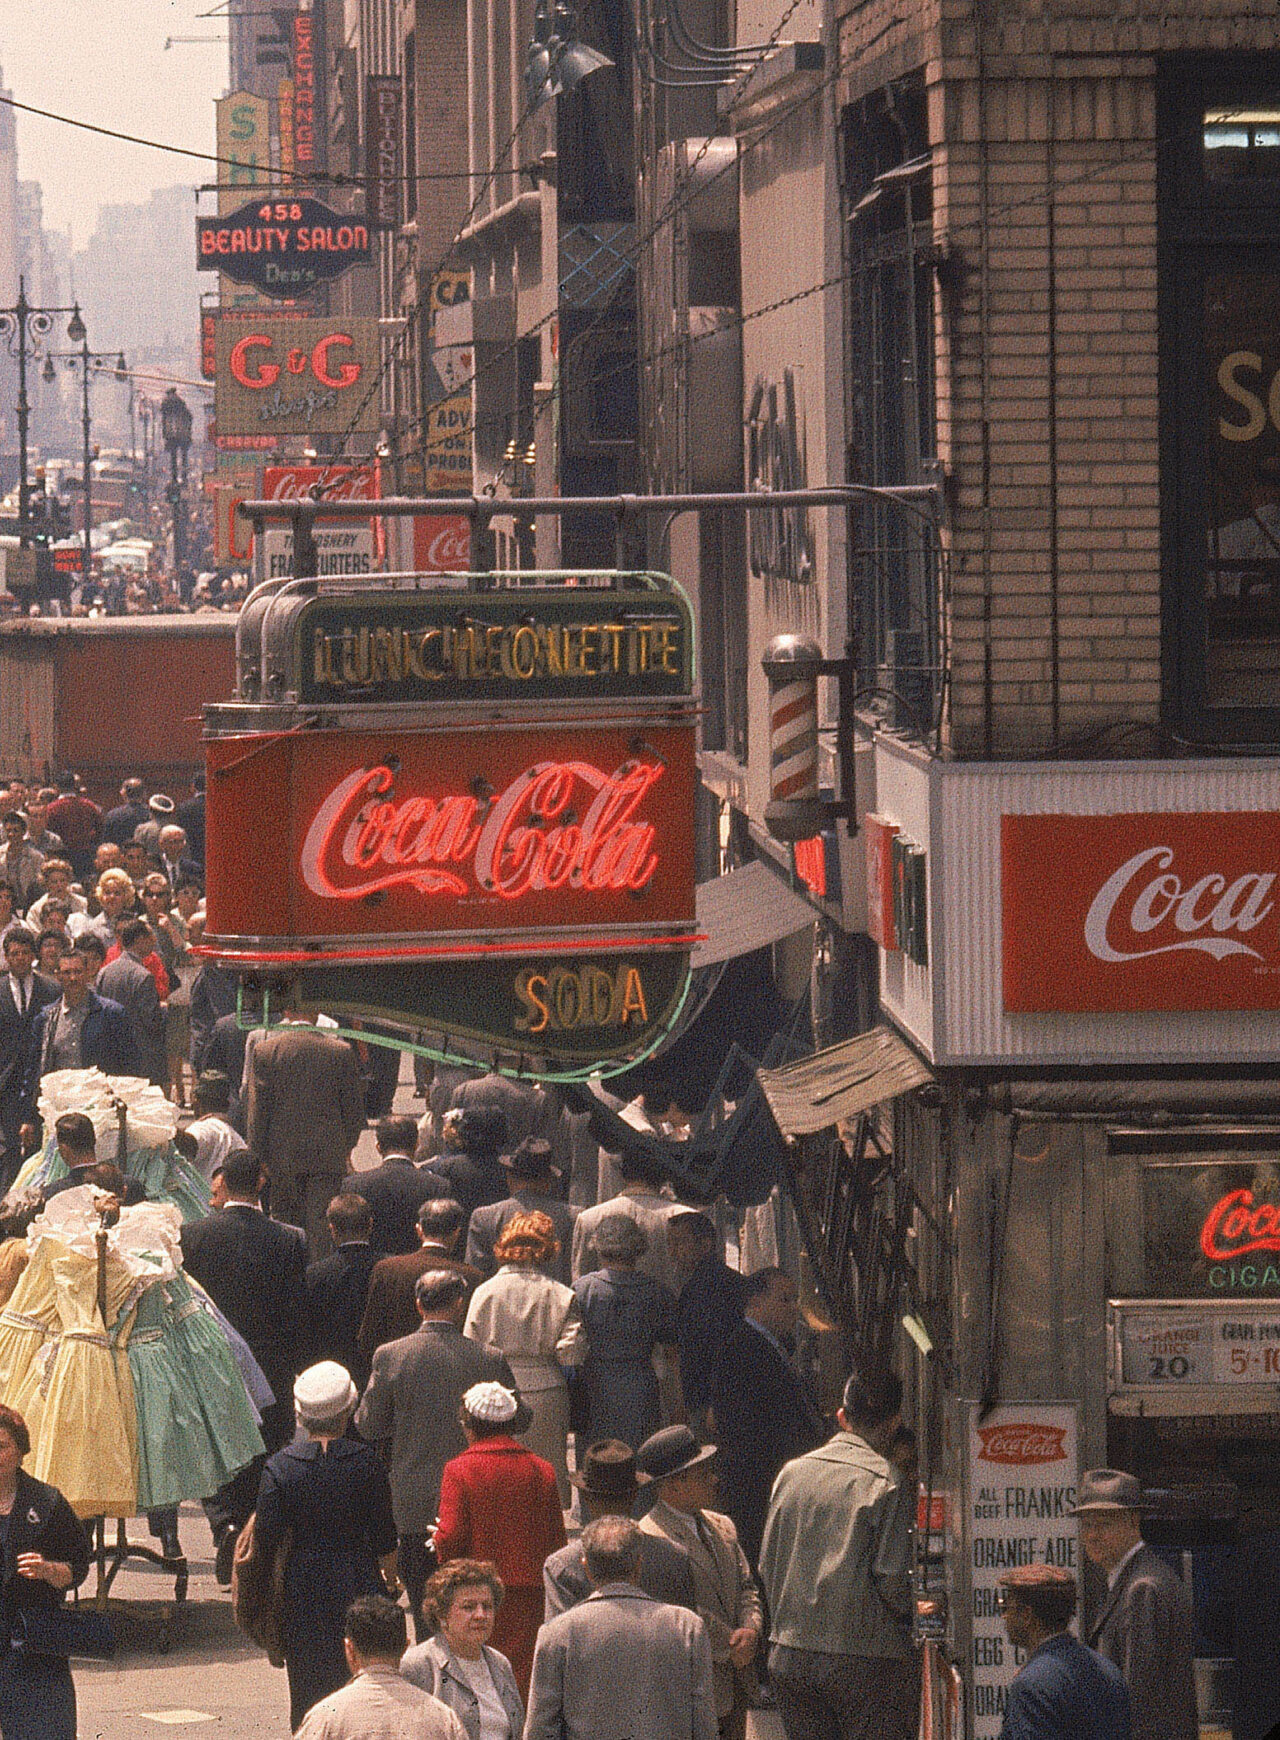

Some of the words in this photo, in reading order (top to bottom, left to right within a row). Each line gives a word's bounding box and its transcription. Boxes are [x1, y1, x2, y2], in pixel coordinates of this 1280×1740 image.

[294, 17, 314, 161] EXCHANGE
[258, 204, 303, 222] 458
[201, 226, 289, 255] BEAUTY
[297, 226, 369, 252] SALON
[269, 553, 370, 577] FRAURTERS
[313, 623, 680, 684] LUNCHEONETTE
[515, 966, 648, 1032] SODA
[1151, 1342, 1189, 1356] JUICE
[974, 1504, 1001, 1520] BEEF
[1005, 1487, 1077, 1518] FRANKS
[979, 1488, 997, 1501] ALL
[974, 1538, 1077, 1567] ORANGE-ADE
[974, 1637, 1004, 1666] EGG
